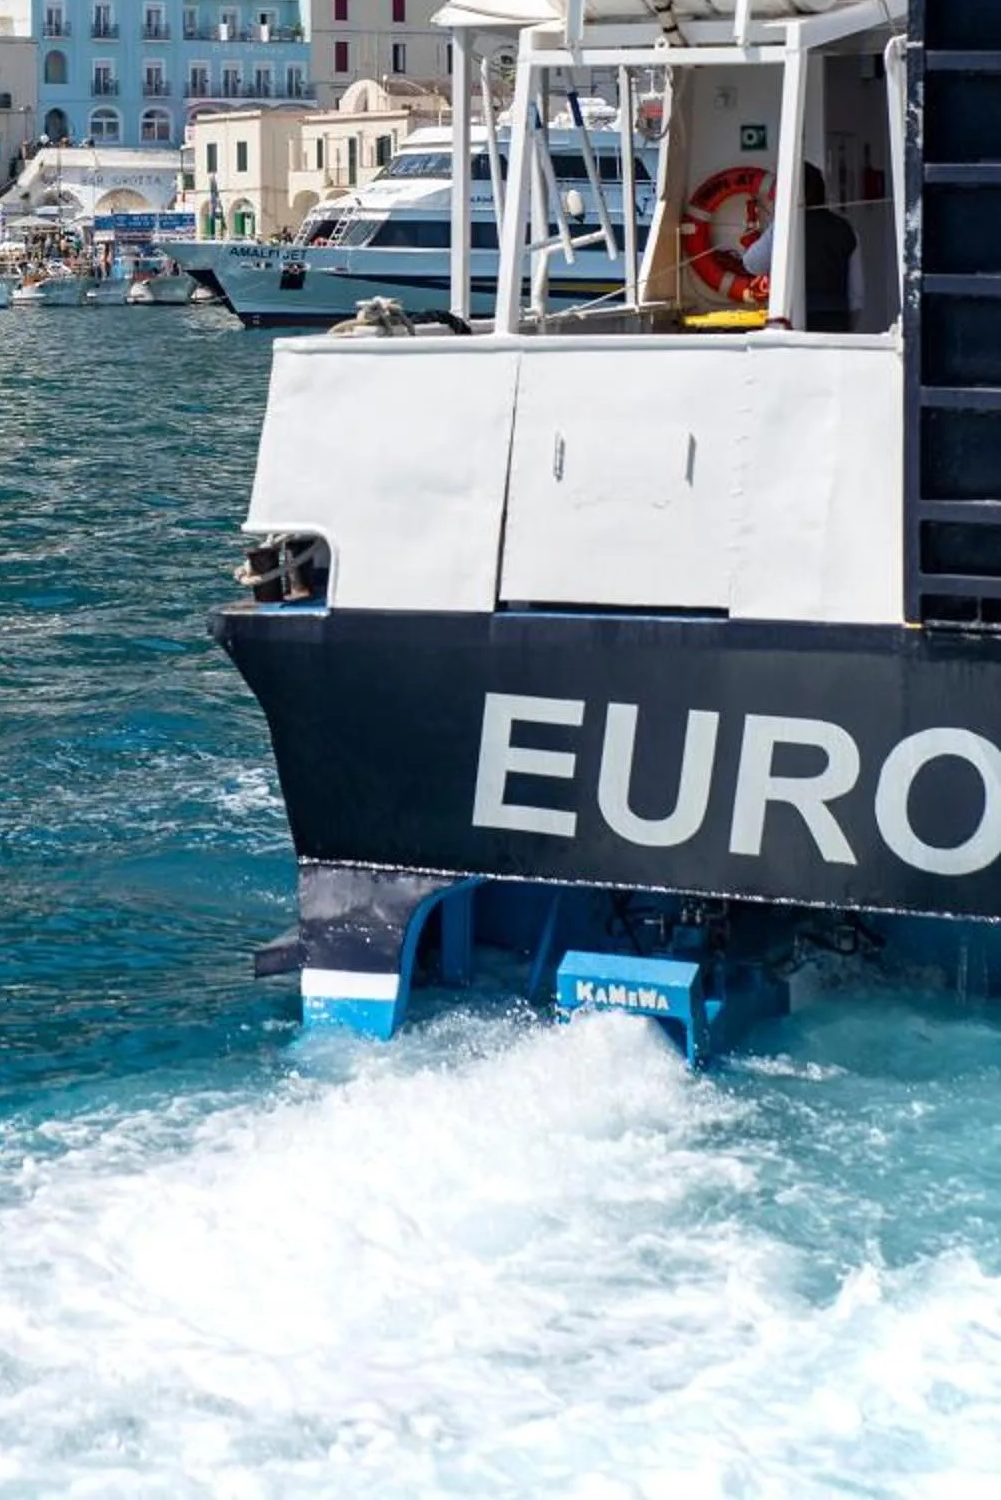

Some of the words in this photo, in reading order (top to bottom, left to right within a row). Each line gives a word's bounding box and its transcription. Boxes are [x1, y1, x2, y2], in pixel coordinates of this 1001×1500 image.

[229, 247, 280, 259] AMALFI
[283, 250, 308, 260] JET
[471, 691, 1001, 875] EURO
